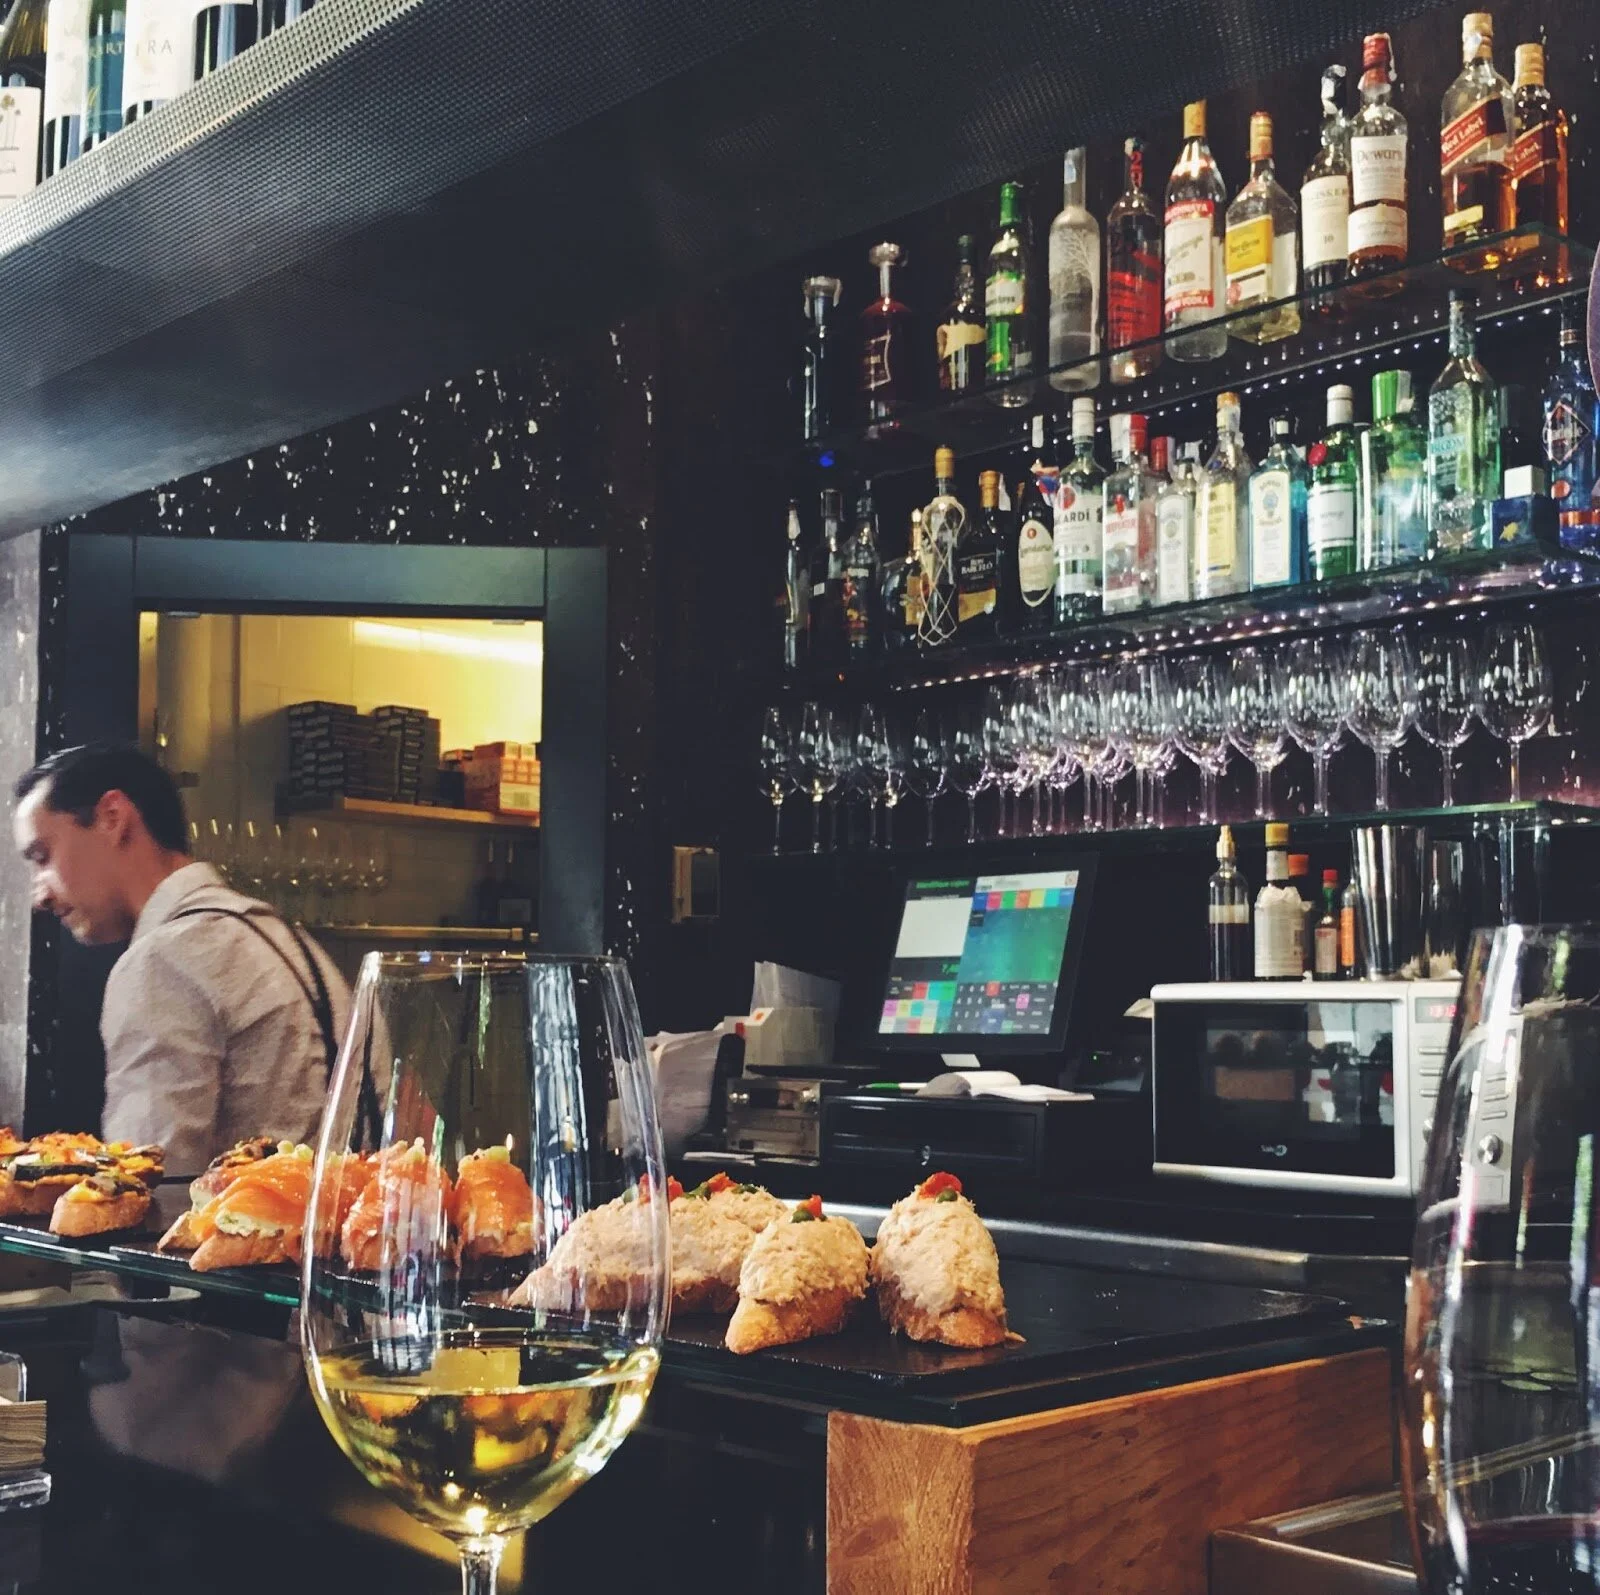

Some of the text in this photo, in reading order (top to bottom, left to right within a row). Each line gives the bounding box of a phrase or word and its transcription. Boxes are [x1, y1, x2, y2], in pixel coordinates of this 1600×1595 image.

[1441, 116, 1484, 154] Red Label
[1514, 141, 1541, 162] Label
